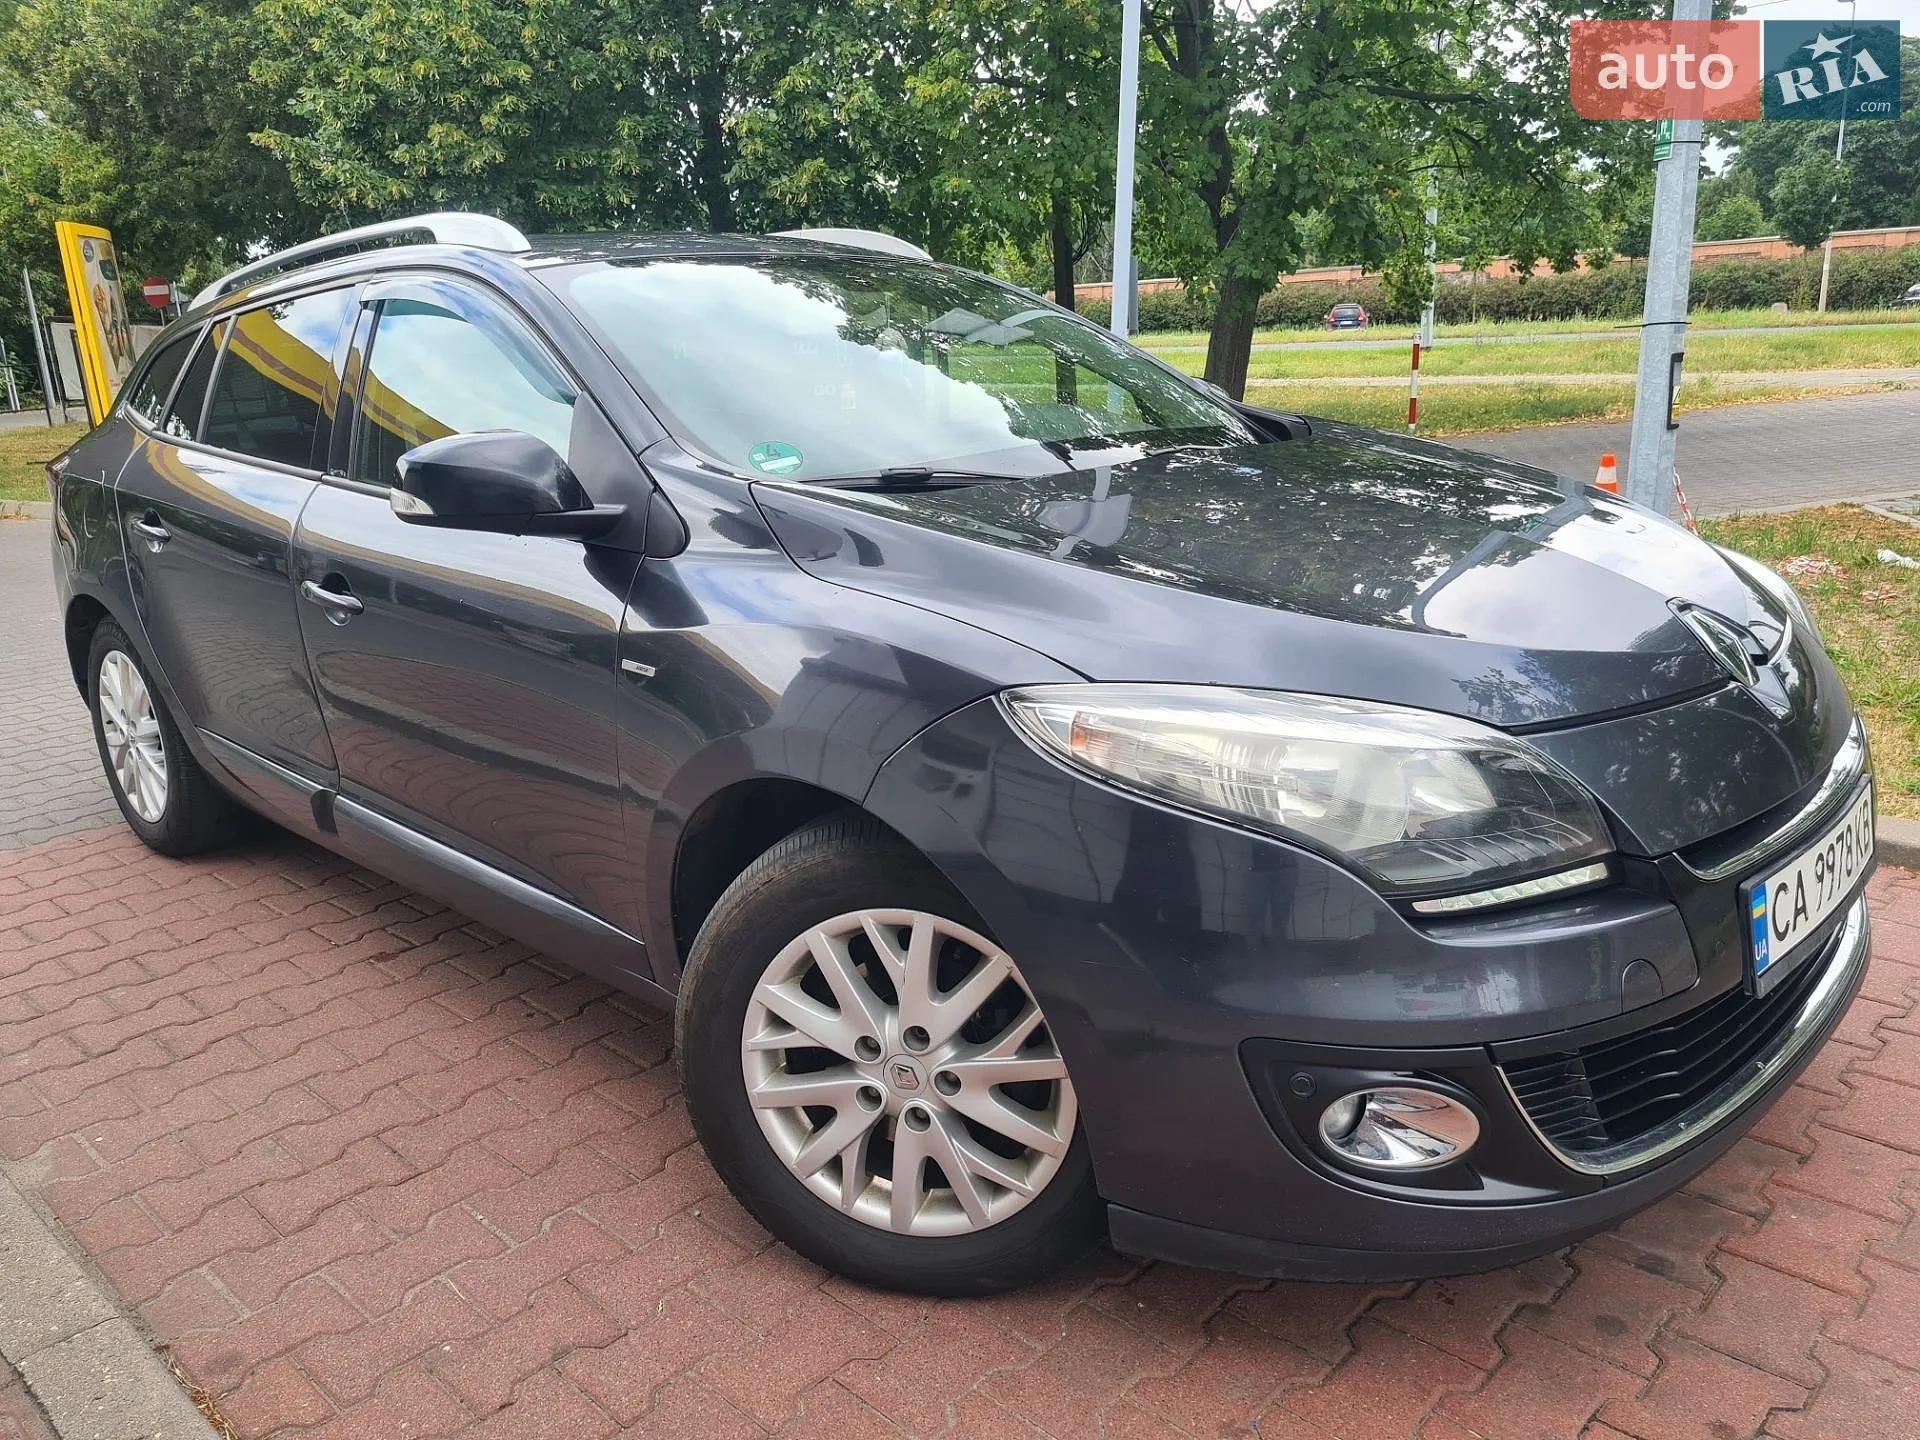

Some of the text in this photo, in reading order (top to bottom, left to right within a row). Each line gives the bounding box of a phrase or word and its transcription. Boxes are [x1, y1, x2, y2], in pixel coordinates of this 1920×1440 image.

[1771, 869, 1809, 942] CA
[1814, 823, 1854, 912] 9978
[1754, 942, 1769, 961] UA
